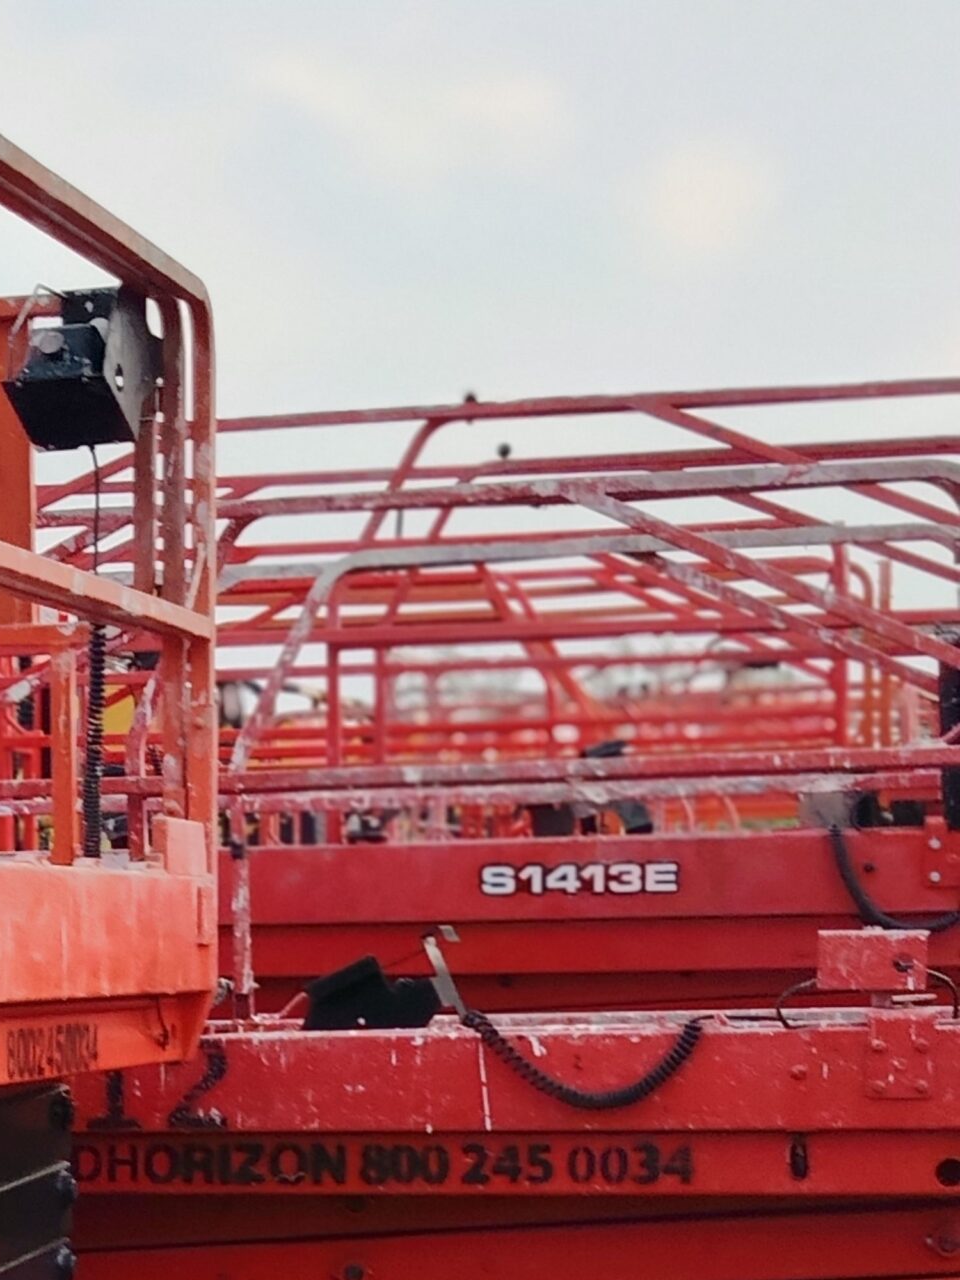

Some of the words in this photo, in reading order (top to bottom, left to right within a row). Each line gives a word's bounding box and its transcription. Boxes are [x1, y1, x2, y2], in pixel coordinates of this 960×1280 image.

[478, 862, 679, 896] S1413E
[361, 1144, 448, 1185] 800
[461, 1144, 553, 1184] 245
[568, 1145, 695, 1184] 0034
